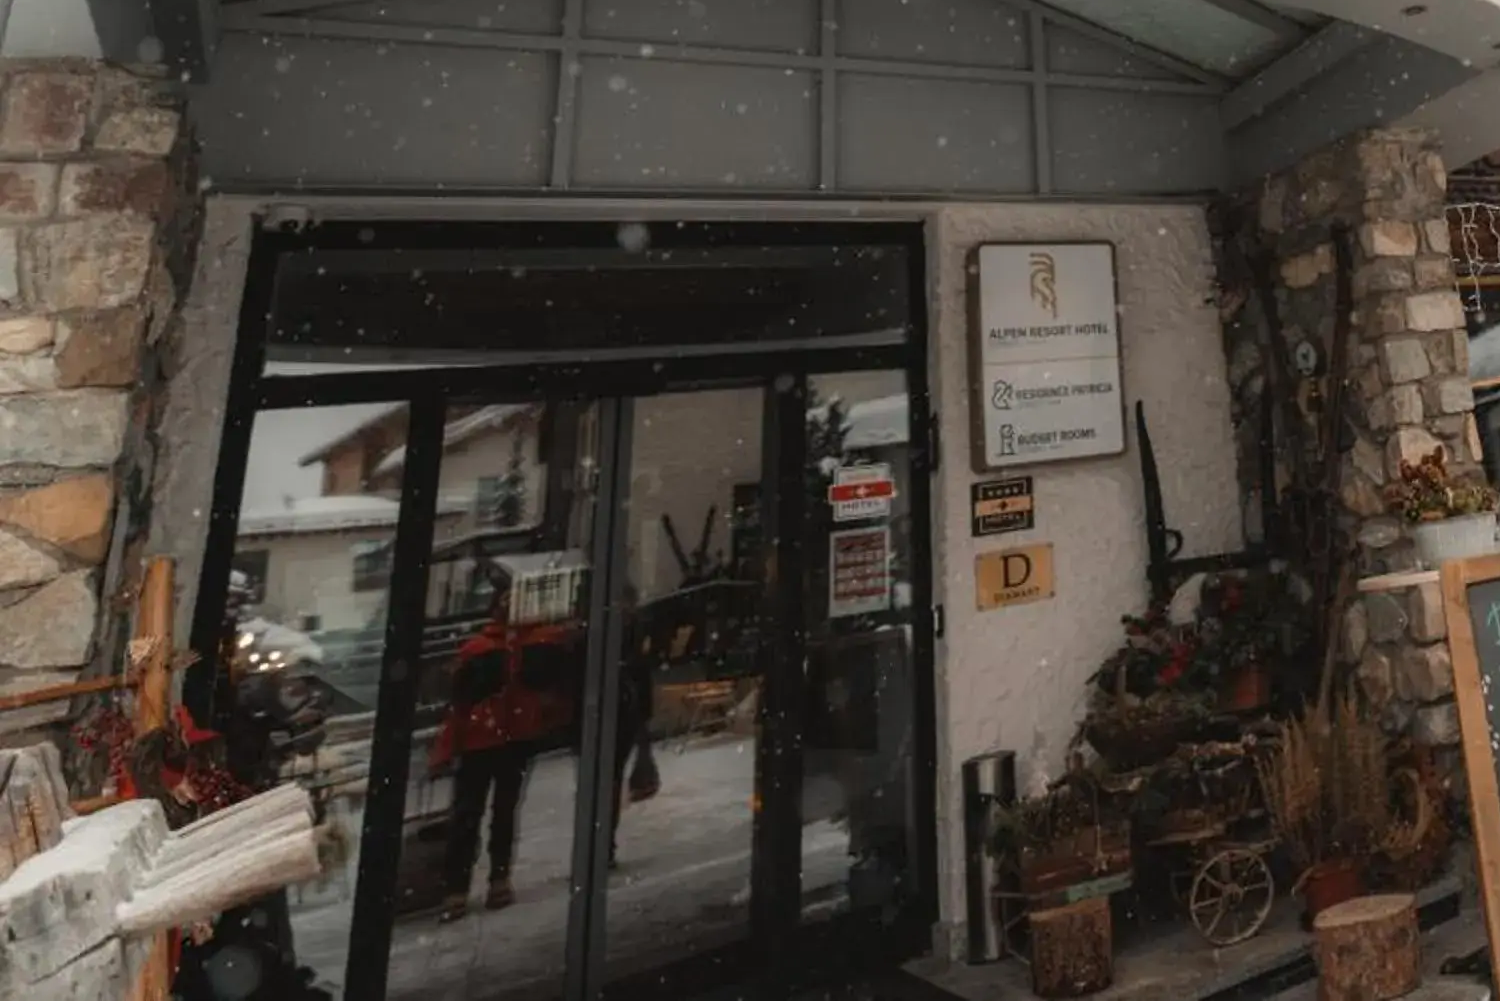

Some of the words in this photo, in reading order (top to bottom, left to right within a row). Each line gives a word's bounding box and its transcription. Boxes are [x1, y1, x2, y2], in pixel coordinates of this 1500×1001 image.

[989, 327, 1027, 339] ALPEN
[1029, 324, 1072, 338] RESORT
[1075, 322, 1109, 336] HOTEL
[1060, 428, 1097, 441] ROOMS
[1000, 552, 1032, 589] D
